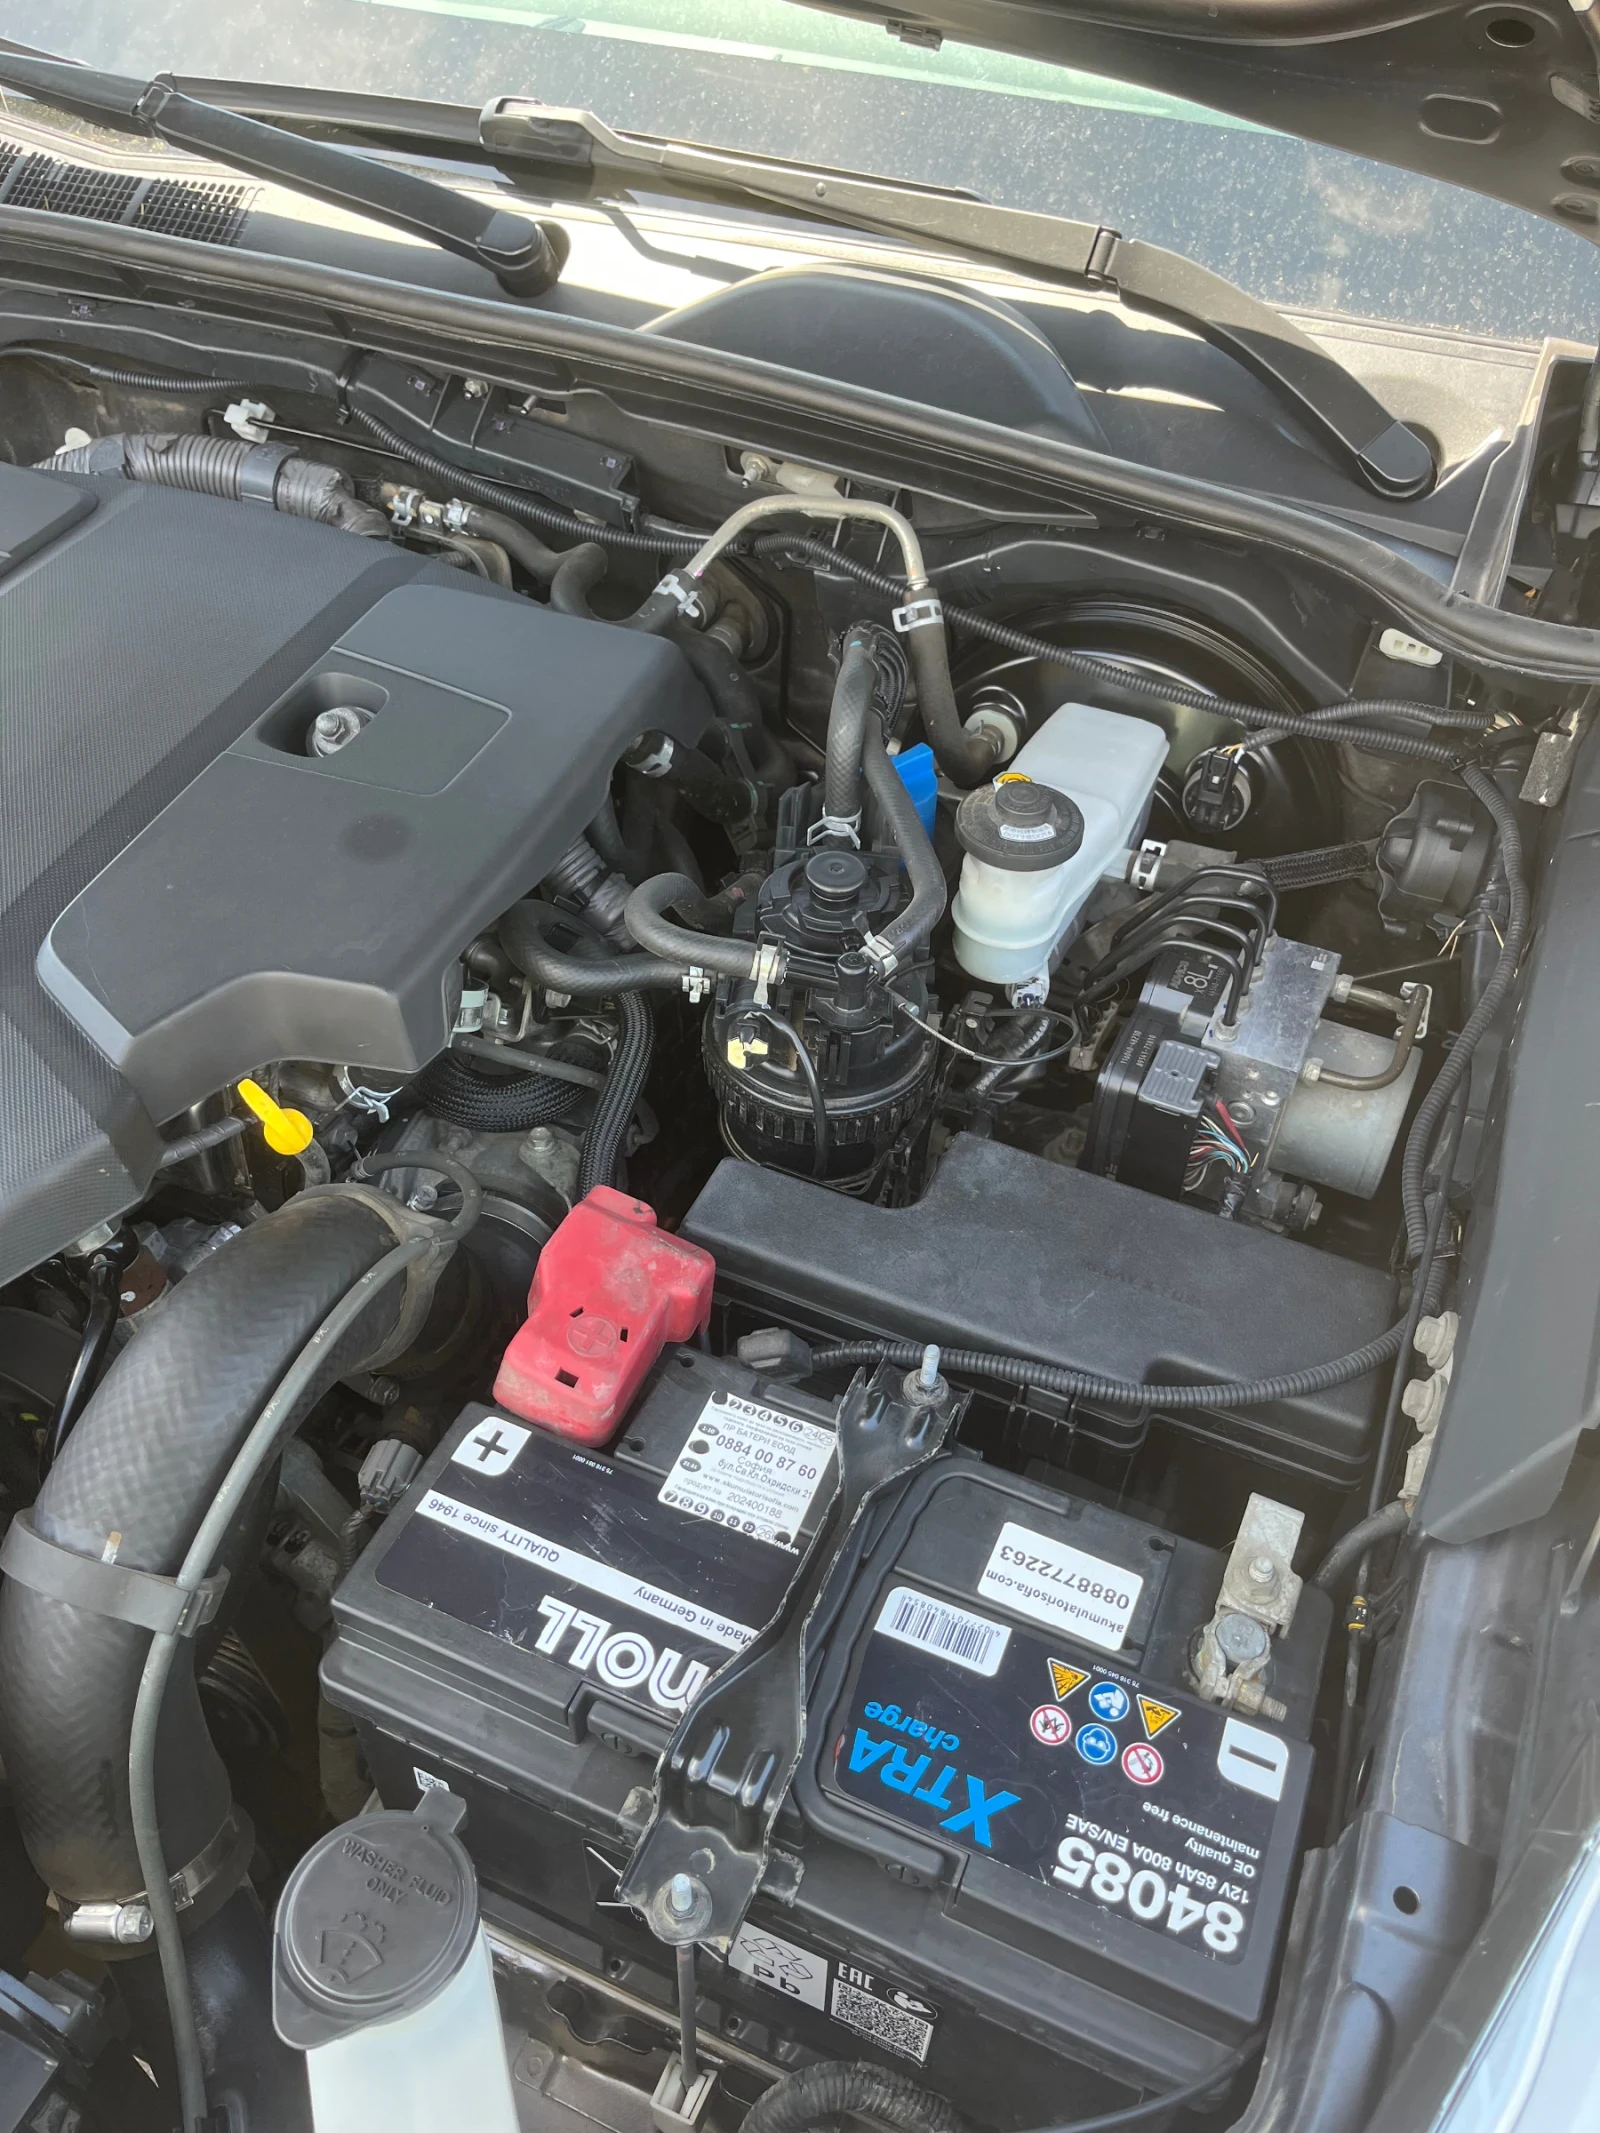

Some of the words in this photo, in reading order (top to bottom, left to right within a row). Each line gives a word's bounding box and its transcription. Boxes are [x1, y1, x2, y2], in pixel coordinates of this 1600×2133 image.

[716, 1434, 751, 1457] 0884
[754, 1449, 774, 1464] 00
[776, 1458, 796, 1472] 87
[799, 1464, 817, 1480] 60
[736, 1428, 770, 1446] БАТЕРИ
[771, 1441, 797, 1456] ЕООД
[737, 1456, 773, 1476] София
[428, 1498, 459, 1519] 1946
[726, 1492, 783, 1519] 202400188
[801, 1488, 813, 1500] 21
[463, 1512, 499, 1534] since
[498, 1532, 560, 1563] QUALITY
[1000, 1544, 1130, 1611] 0888772263
[634, 1586, 697, 1623] Germany
[985, 1568, 1125, 1634] akumulatorisofia.com
[700, 1616, 714, 1631] in
[864, 1701, 960, 1752] charge
[848, 1727, 1022, 1848] XTRA
[1142, 1801, 1170, 1822] free
[1065, 1813, 1129, 1853] EN/SAE
[1171, 1813, 1260, 1860] maintenance
[1132, 1842, 1172, 1871] 800A
[1185, 1837, 1231, 1866] quality
[342, 1839, 408, 1882] WASHER
[409, 1875, 453, 1905] FLUID
[1175, 1861, 1217, 1891] 85Ah
[1233, 1858, 1255, 1878] OE
[366, 1876, 408, 1905] ONLY
[1052, 1836, 1244, 1953] 84085
[1218, 1880, 1249, 1904] 12V
[753, 1963, 801, 1995] Pb
[837, 1962, 875, 1992] EAC
